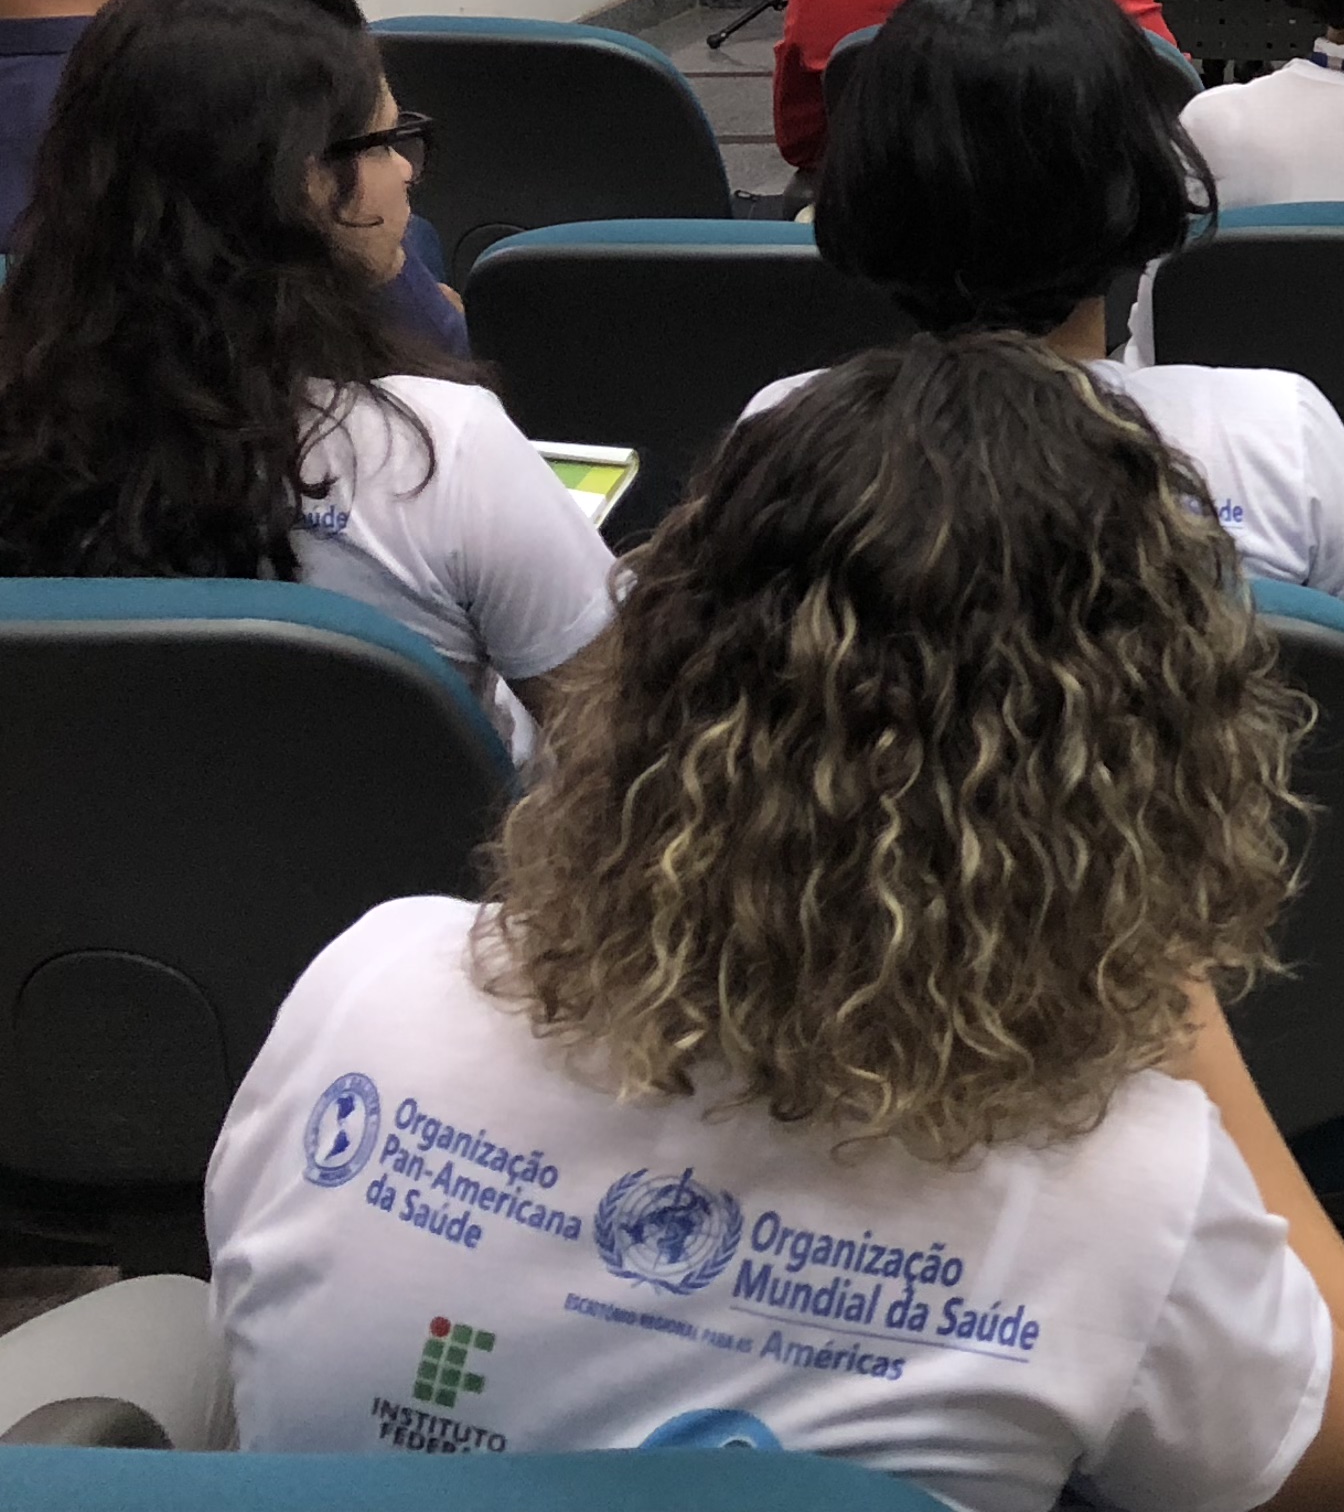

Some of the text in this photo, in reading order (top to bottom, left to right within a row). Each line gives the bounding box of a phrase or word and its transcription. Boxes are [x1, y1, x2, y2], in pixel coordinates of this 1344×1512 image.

[394, 1097, 560, 1192] Organização
[366, 1175, 483, 1249] da Saúde
[379, 1134, 582, 1242] Pan-Americana
[750, 1211, 963, 1288] Organização
[732, 1260, 1040, 1351] Mundial da Saúde
[759, 1331, 906, 1381] Américas
[370, 1397, 508, 1454] INSTITUTO
